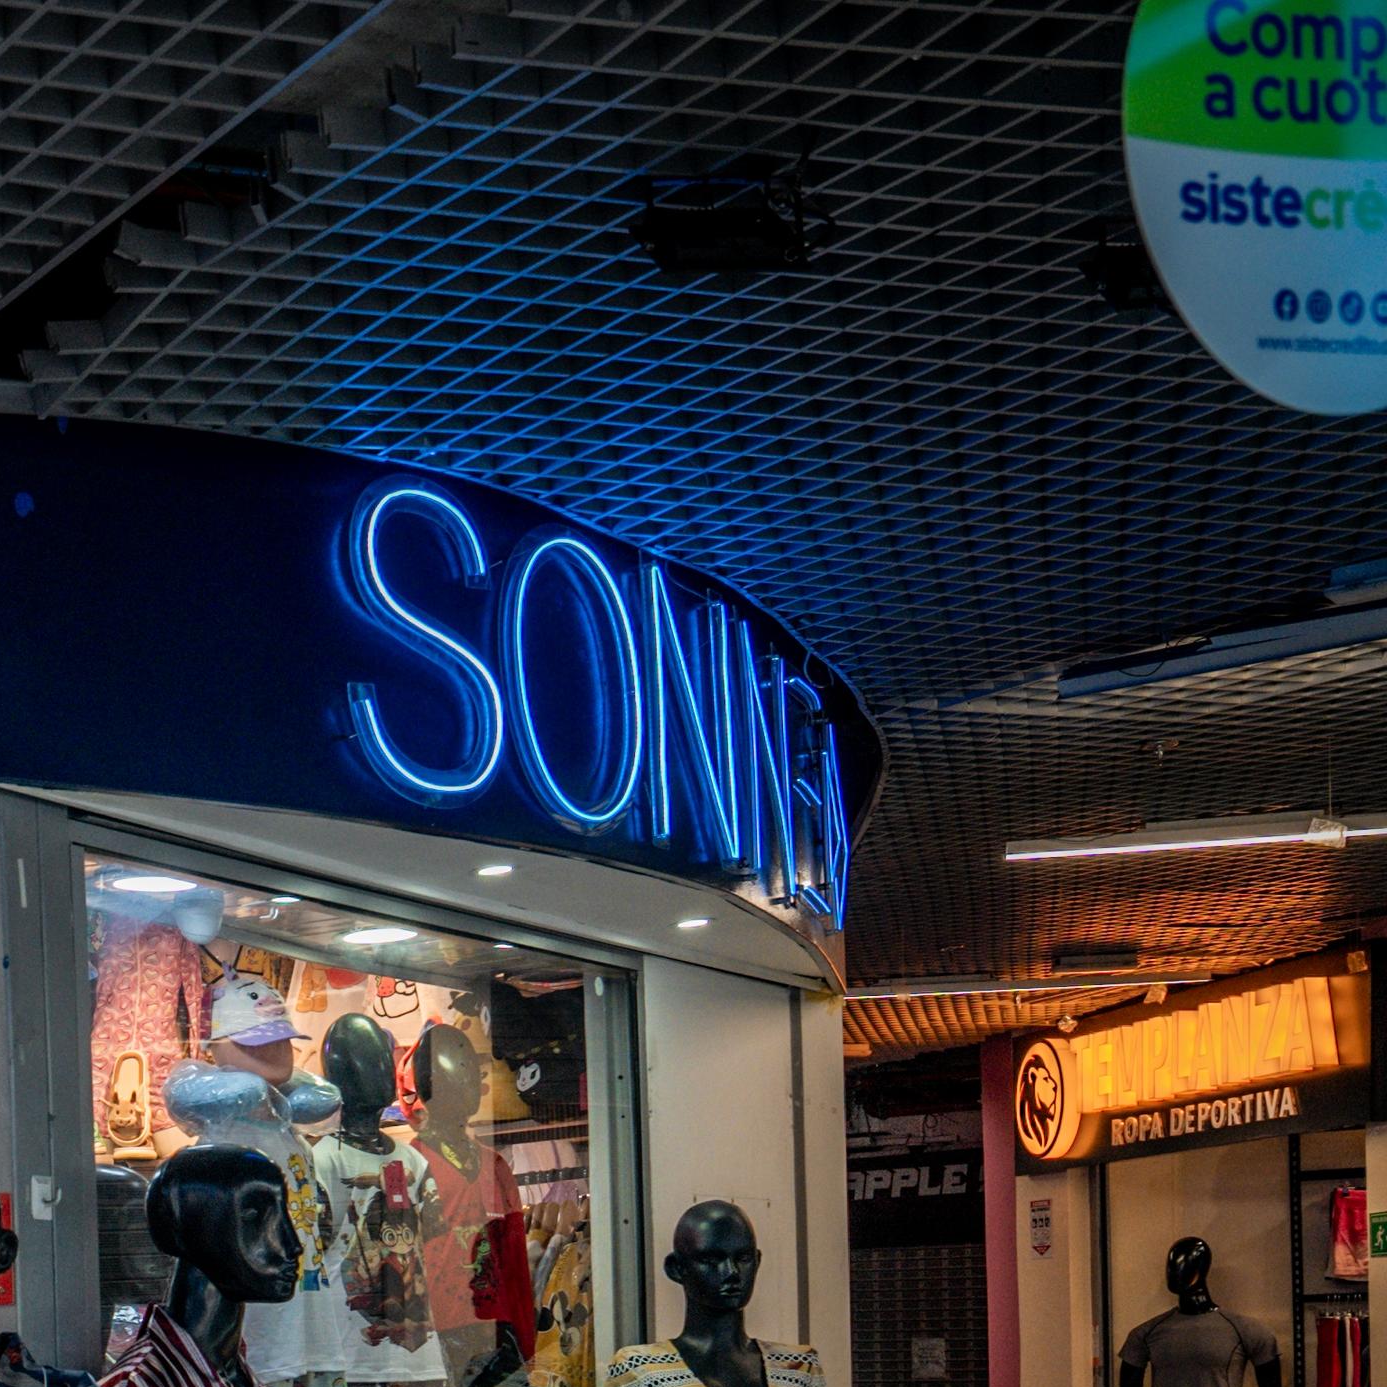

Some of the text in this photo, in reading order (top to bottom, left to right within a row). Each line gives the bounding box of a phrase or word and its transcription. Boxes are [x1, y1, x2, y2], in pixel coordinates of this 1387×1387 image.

[1204, 0, 1387, 77] Comp
[1205, 67, 1387, 126] a cuot
[1070, 977, 1335, 1113] TEMPLANZA
[1111, 1086, 1299, 1146] ROPA DEPORTIVA
[847, 1164, 968, 1200] APPLE
